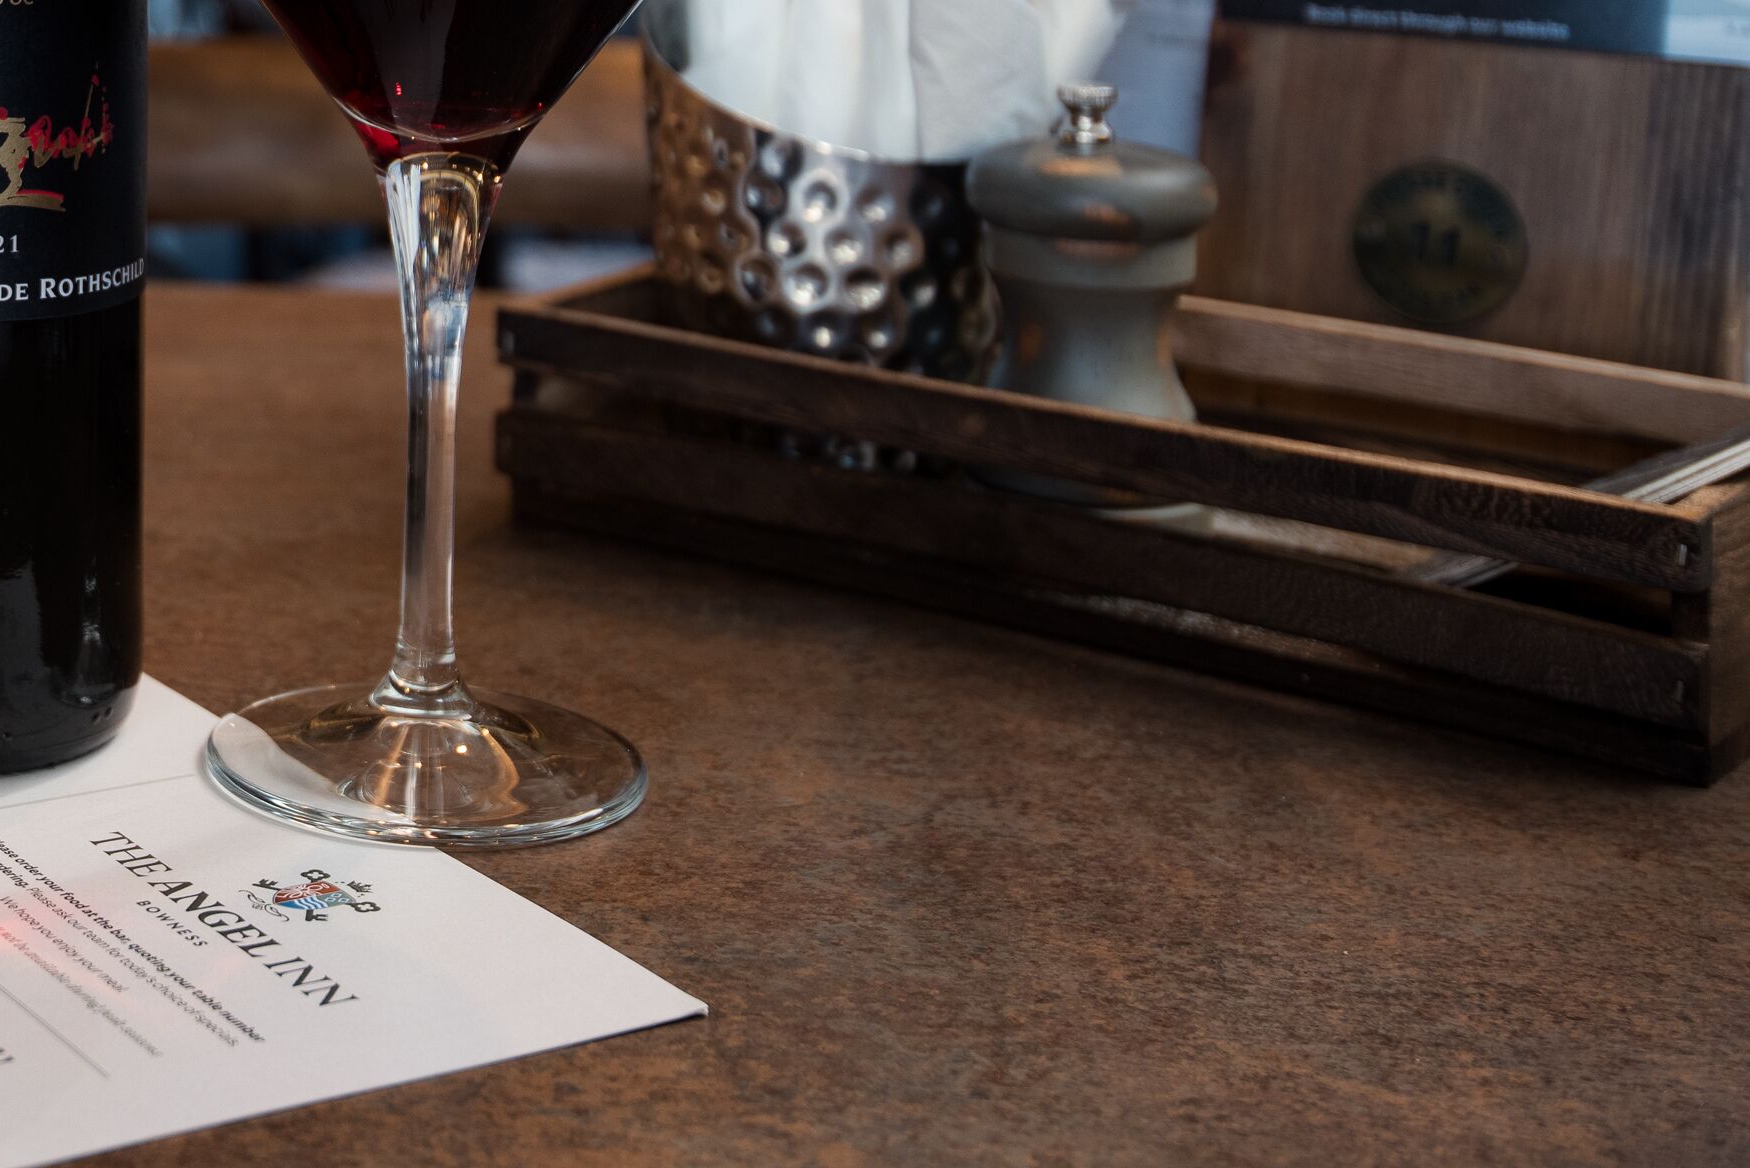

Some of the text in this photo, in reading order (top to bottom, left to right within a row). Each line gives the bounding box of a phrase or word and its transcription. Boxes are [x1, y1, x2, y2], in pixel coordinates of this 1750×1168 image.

[39, 257, 145, 301] ROTHSCHILD
[13, 907, 40, 927] hope
[51, 937, 82, 957] enjoy
[71, 956, 103, 973] your
[13, 857, 44, 876] order
[34, 875, 65, 892] your
[59, 891, 90, 909] food
[80, 908, 98, 917] at
[92, 915, 114, 930] the
[108, 928, 131, 944] bar,
[127, 942, 171, 973] quoting
[163, 971, 196, 989] your
[191, 989, 223, 1011] table
[218, 1009, 265, 1041] number
[25, 886, 57, 908] Please
[50, 907, 73, 920] ask
[65, 918, 88, 930] our
[81, 929, 110, 949] team
[118, 957, 157, 984] today's
[151, 981, 188, 1007] choice
[88, 830, 358, 1006] THE ANGEL INN
[135, 899, 208, 947] BOWNESS
